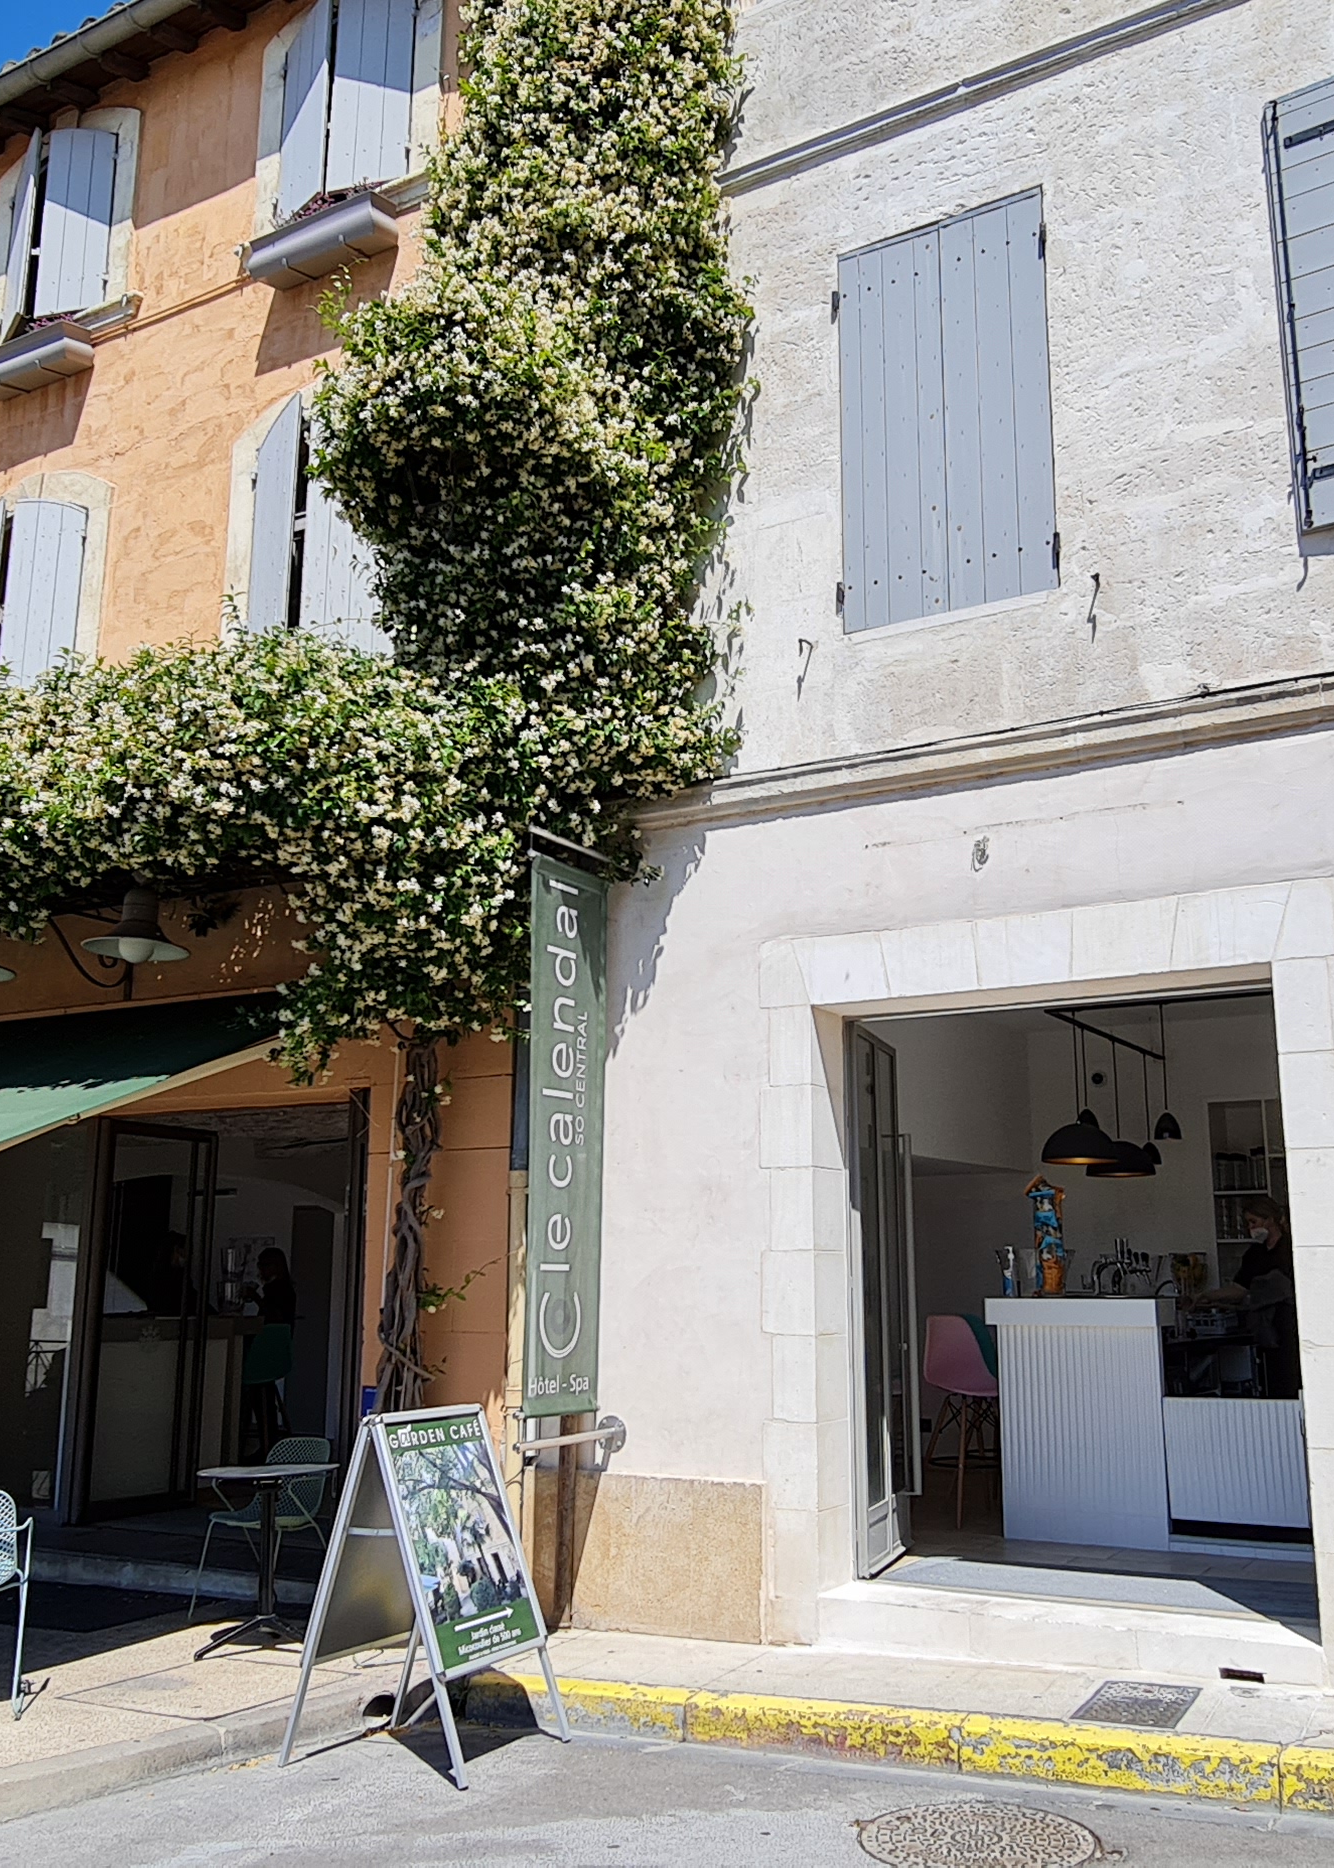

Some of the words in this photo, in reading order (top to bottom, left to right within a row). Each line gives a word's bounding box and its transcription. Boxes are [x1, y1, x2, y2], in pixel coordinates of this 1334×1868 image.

[575, 1010, 588, 1109] CENTRAL
[574, 1115, 585, 1146] SO
[528, 1375, 560, 1399] Hôtel
[569, 1373, 590, 1396] Spa
[449, 1419, 482, 1440] CAFÉ
